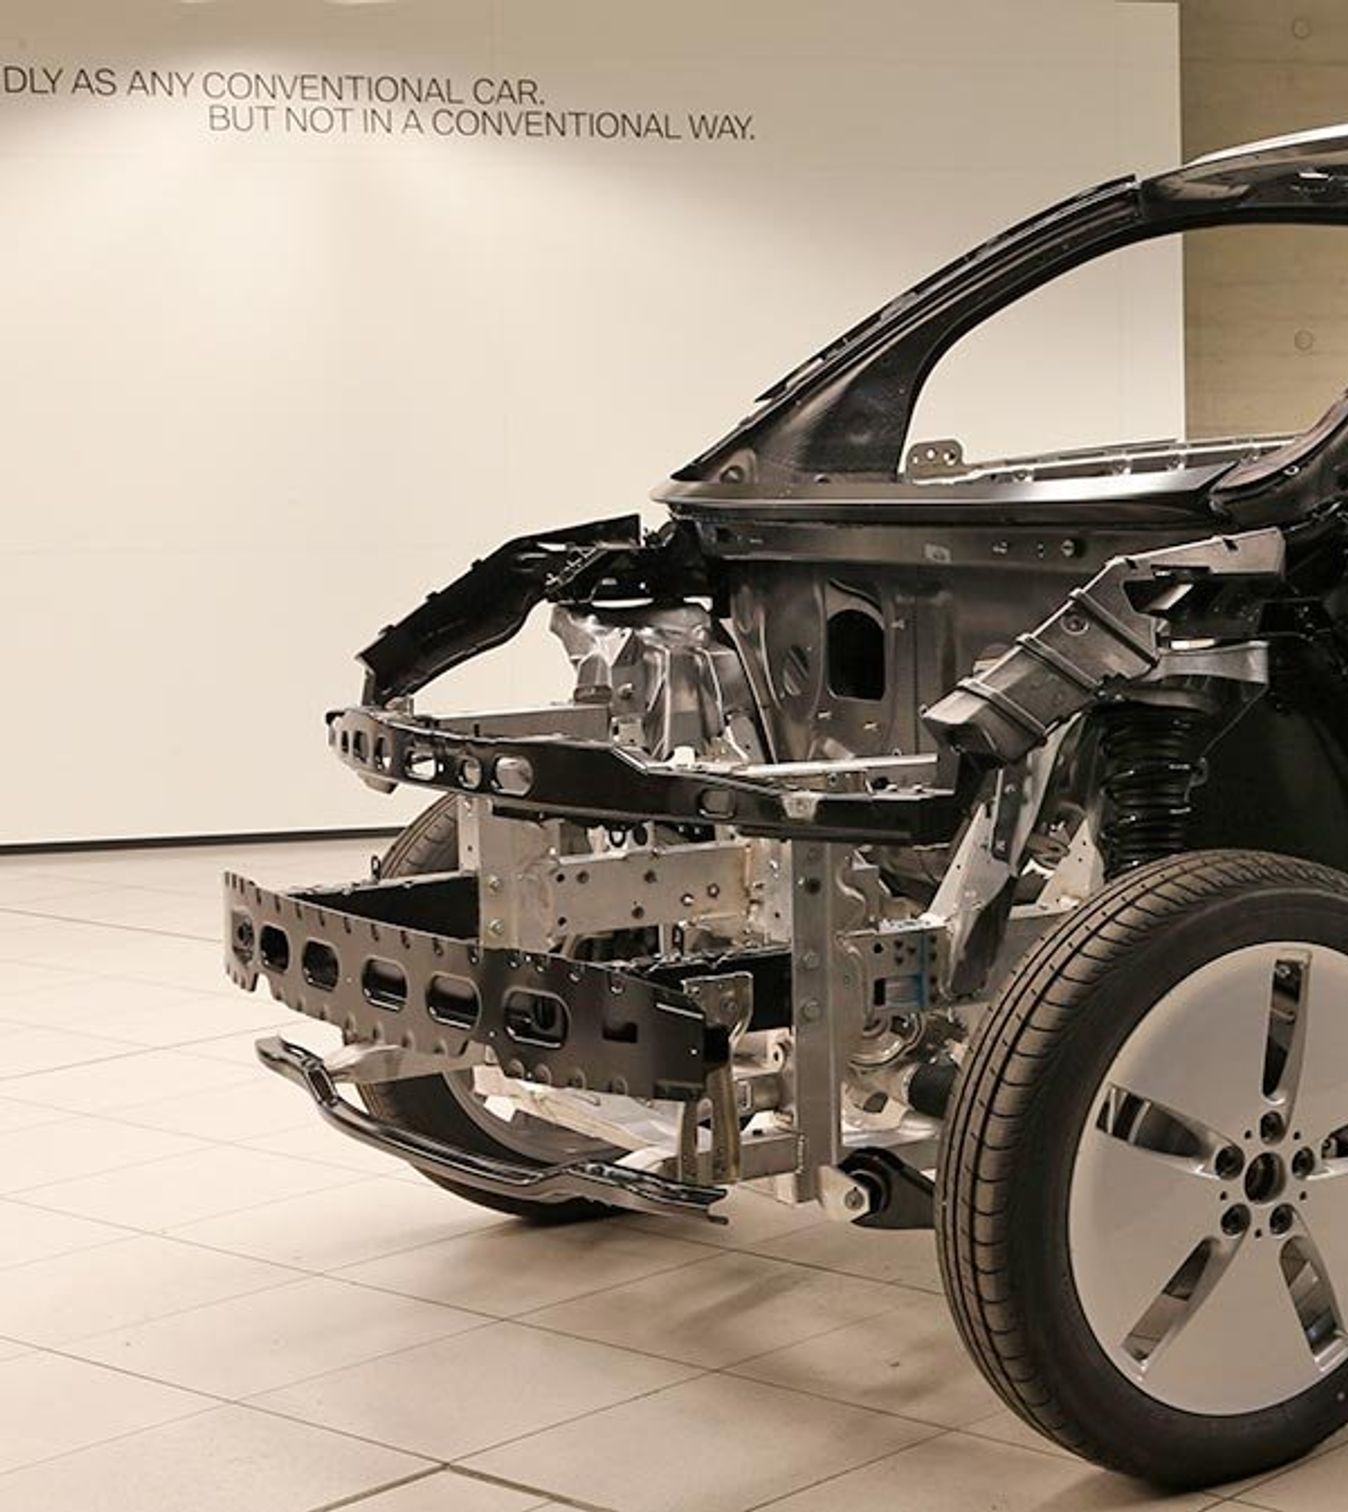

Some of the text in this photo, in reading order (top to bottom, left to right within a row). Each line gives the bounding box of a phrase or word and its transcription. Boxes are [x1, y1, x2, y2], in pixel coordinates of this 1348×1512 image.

[3, 66, 545, 106] DLY AS ANY CONVENTIONAL CAR.
[208, 104, 756, 141] BUT NOT IN A CONVENTIONAL WAY.
